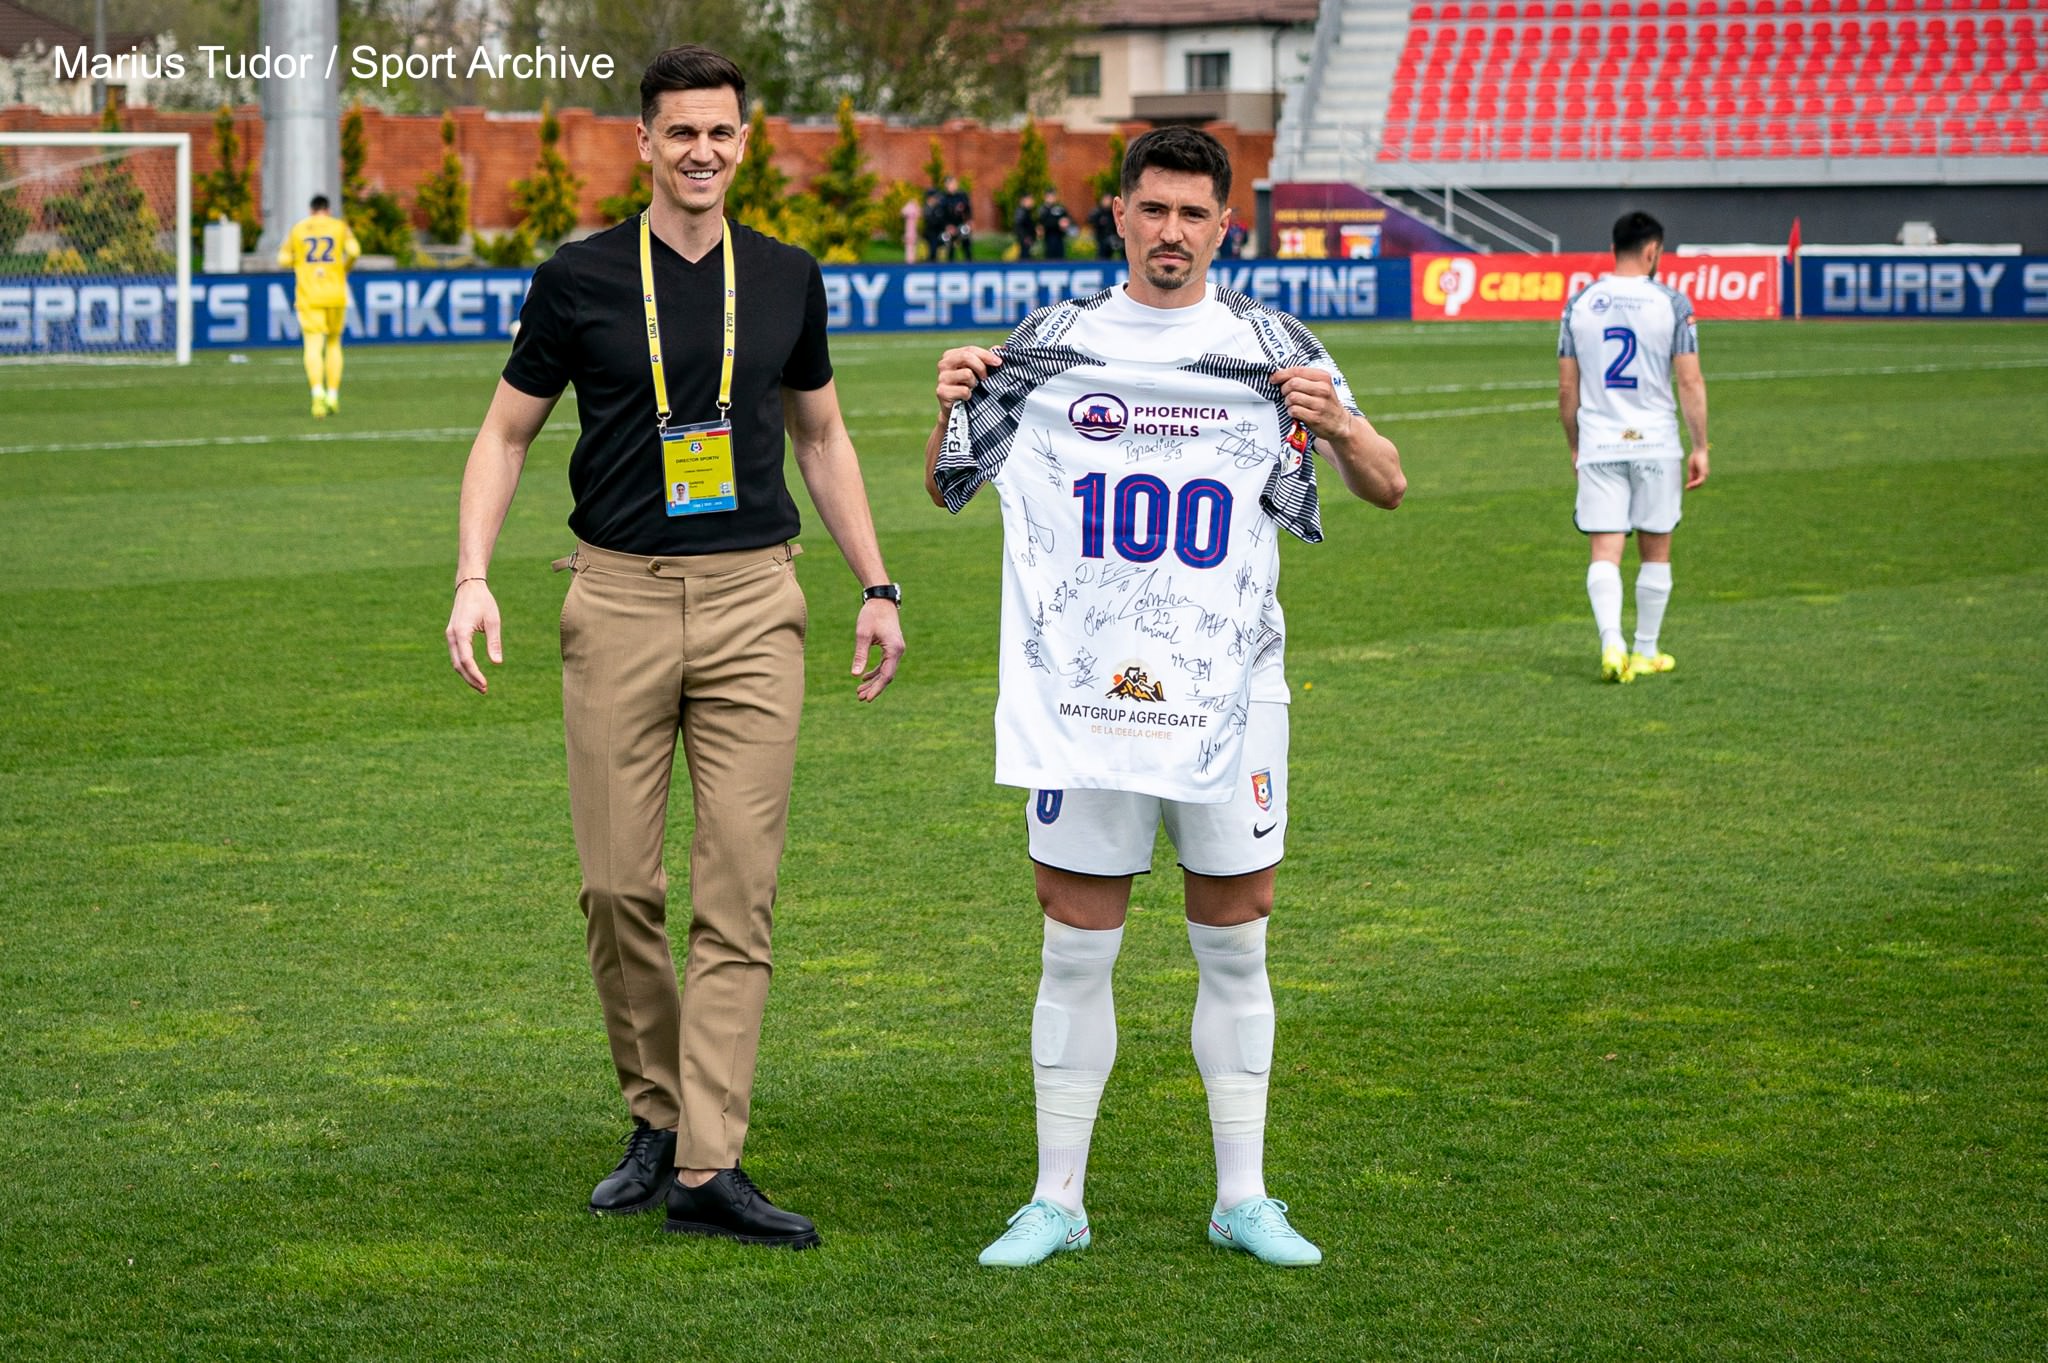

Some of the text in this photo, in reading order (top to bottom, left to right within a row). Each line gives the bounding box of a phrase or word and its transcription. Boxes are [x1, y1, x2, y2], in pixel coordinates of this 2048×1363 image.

[303, 237, 334, 262] 22
[1207, 265, 1378, 316] KETING
[1479, 264, 1766, 301] casa purilor
[1822, 263, 2005, 312] DURBY
[267, 278, 530, 341] MRKET
[1037, 309, 1071, 348] ARGOVIS
[1603, 326, 1638, 389] 2
[1133, 423, 1200, 437] HOTELS
[1134, 406, 1229, 421] PHOENICIA
[1073, 472, 1234, 569] 100
[1059, 703, 1127, 722] MATGRUP
[1128, 711, 1208, 728] AGREGATE
[1091, 725, 1102, 734] DE
